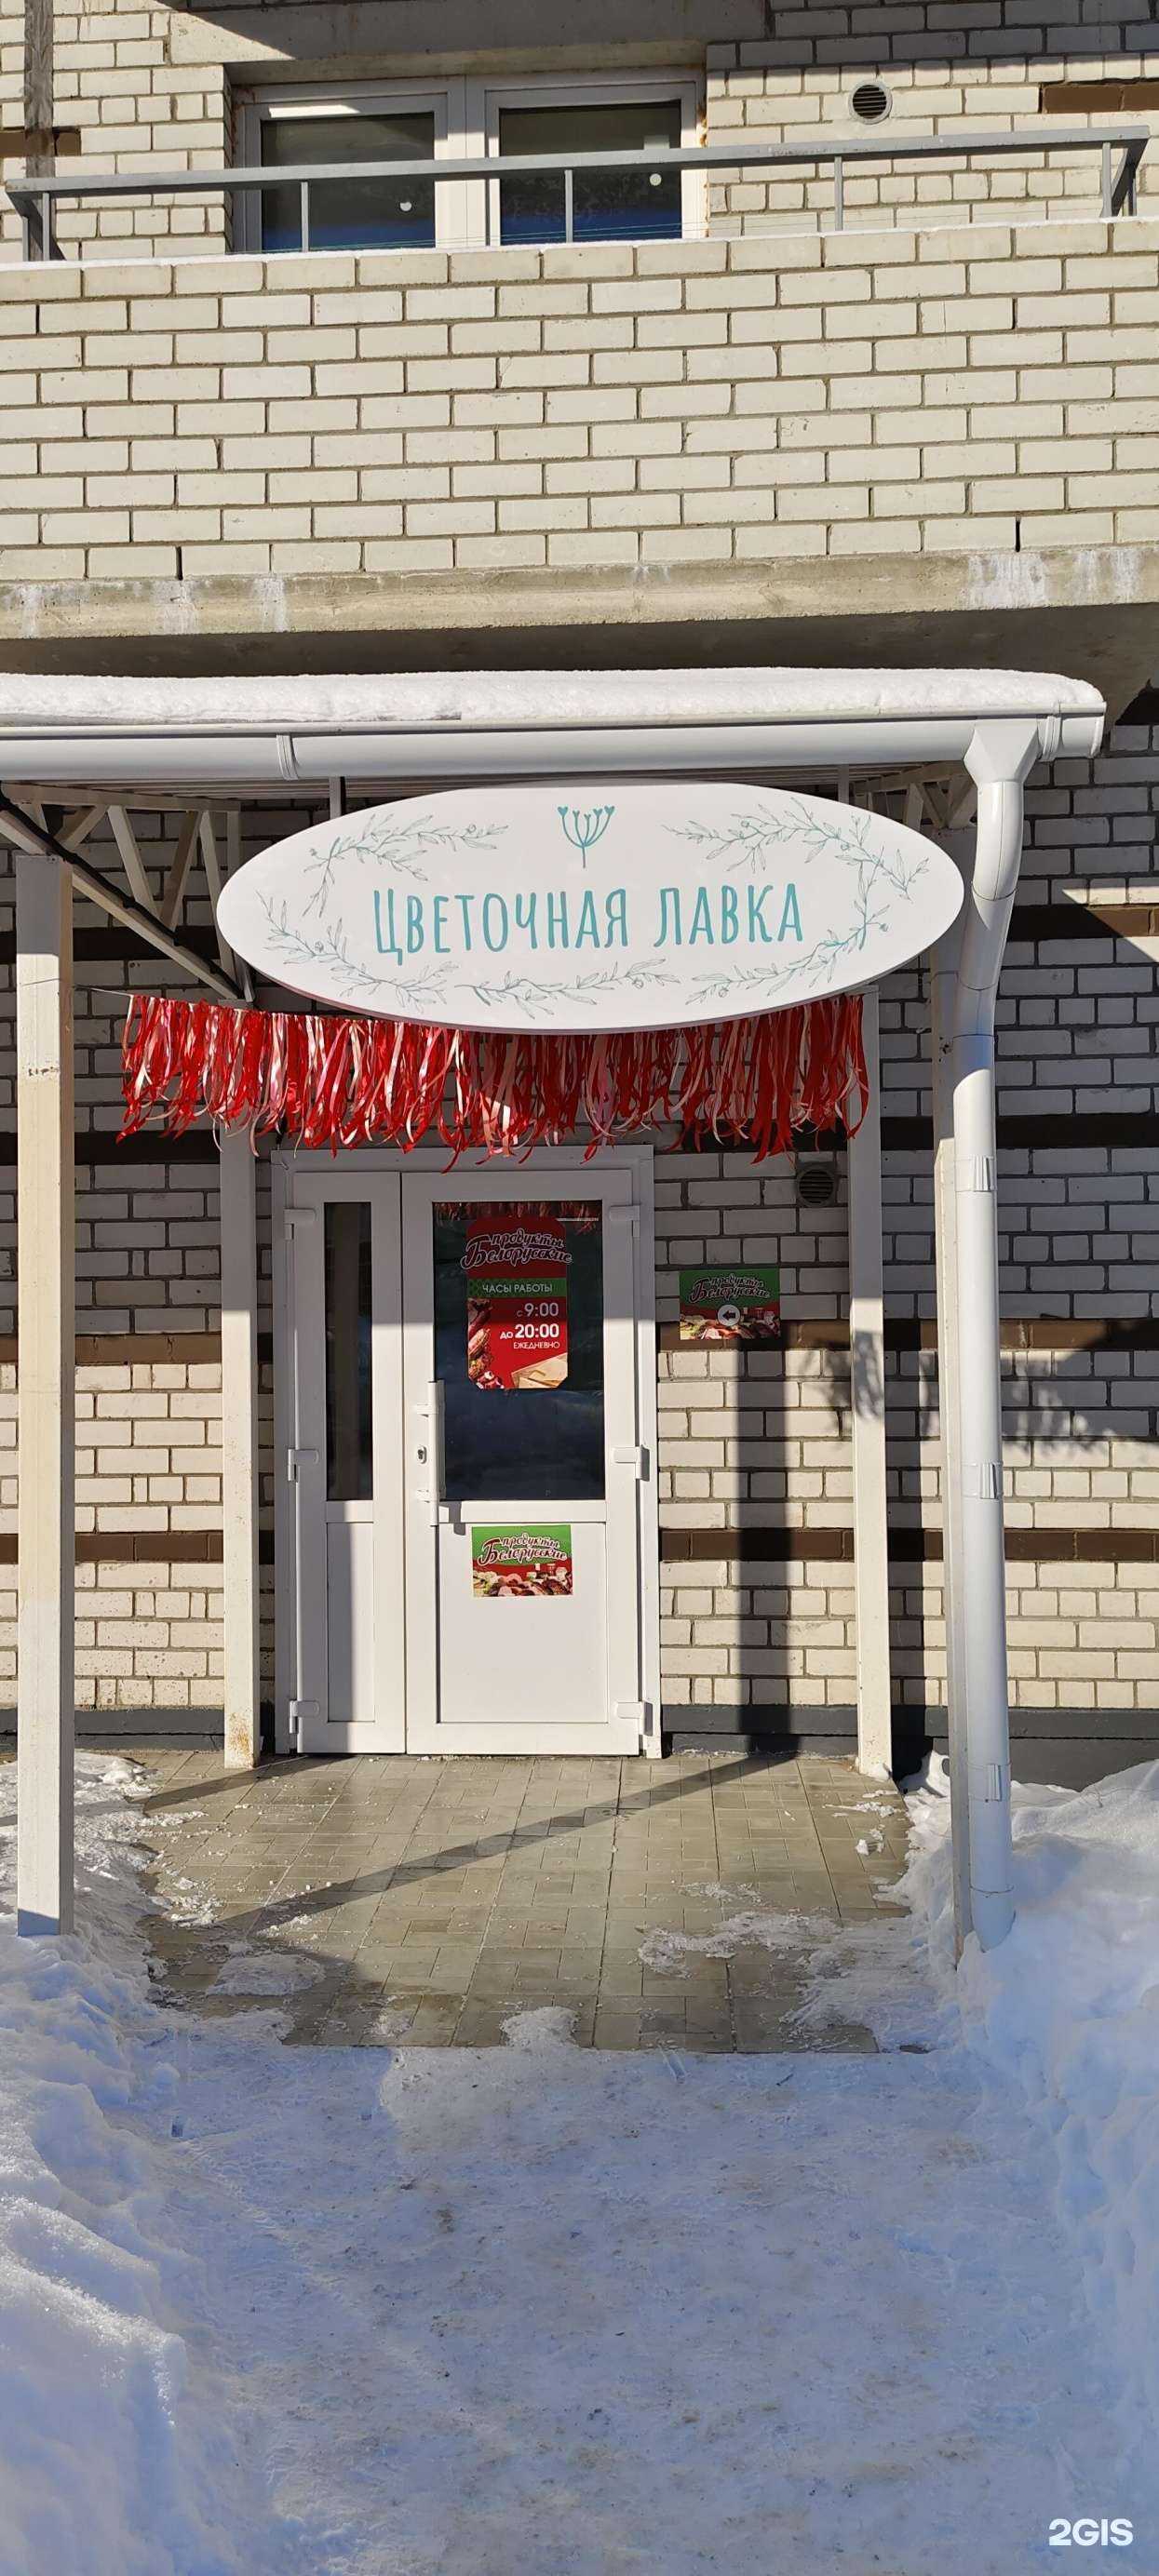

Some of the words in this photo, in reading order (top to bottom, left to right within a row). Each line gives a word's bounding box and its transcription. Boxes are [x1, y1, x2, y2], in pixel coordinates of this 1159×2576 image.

[373, 887, 629, 966] ЦВЕТОЧНАЯ
[654, 883, 803, 947] ЛАВКА
[482, 1284, 512, 1294] ЧАСЫ
[514, 1283, 553, 1293] РАБОТЫ
[524, 1302, 559, 1317] 9:00
[514, 1322, 559, 1338] 20:00
[513, 1341, 560, 1349] ЕЖЕДНЕВНО
